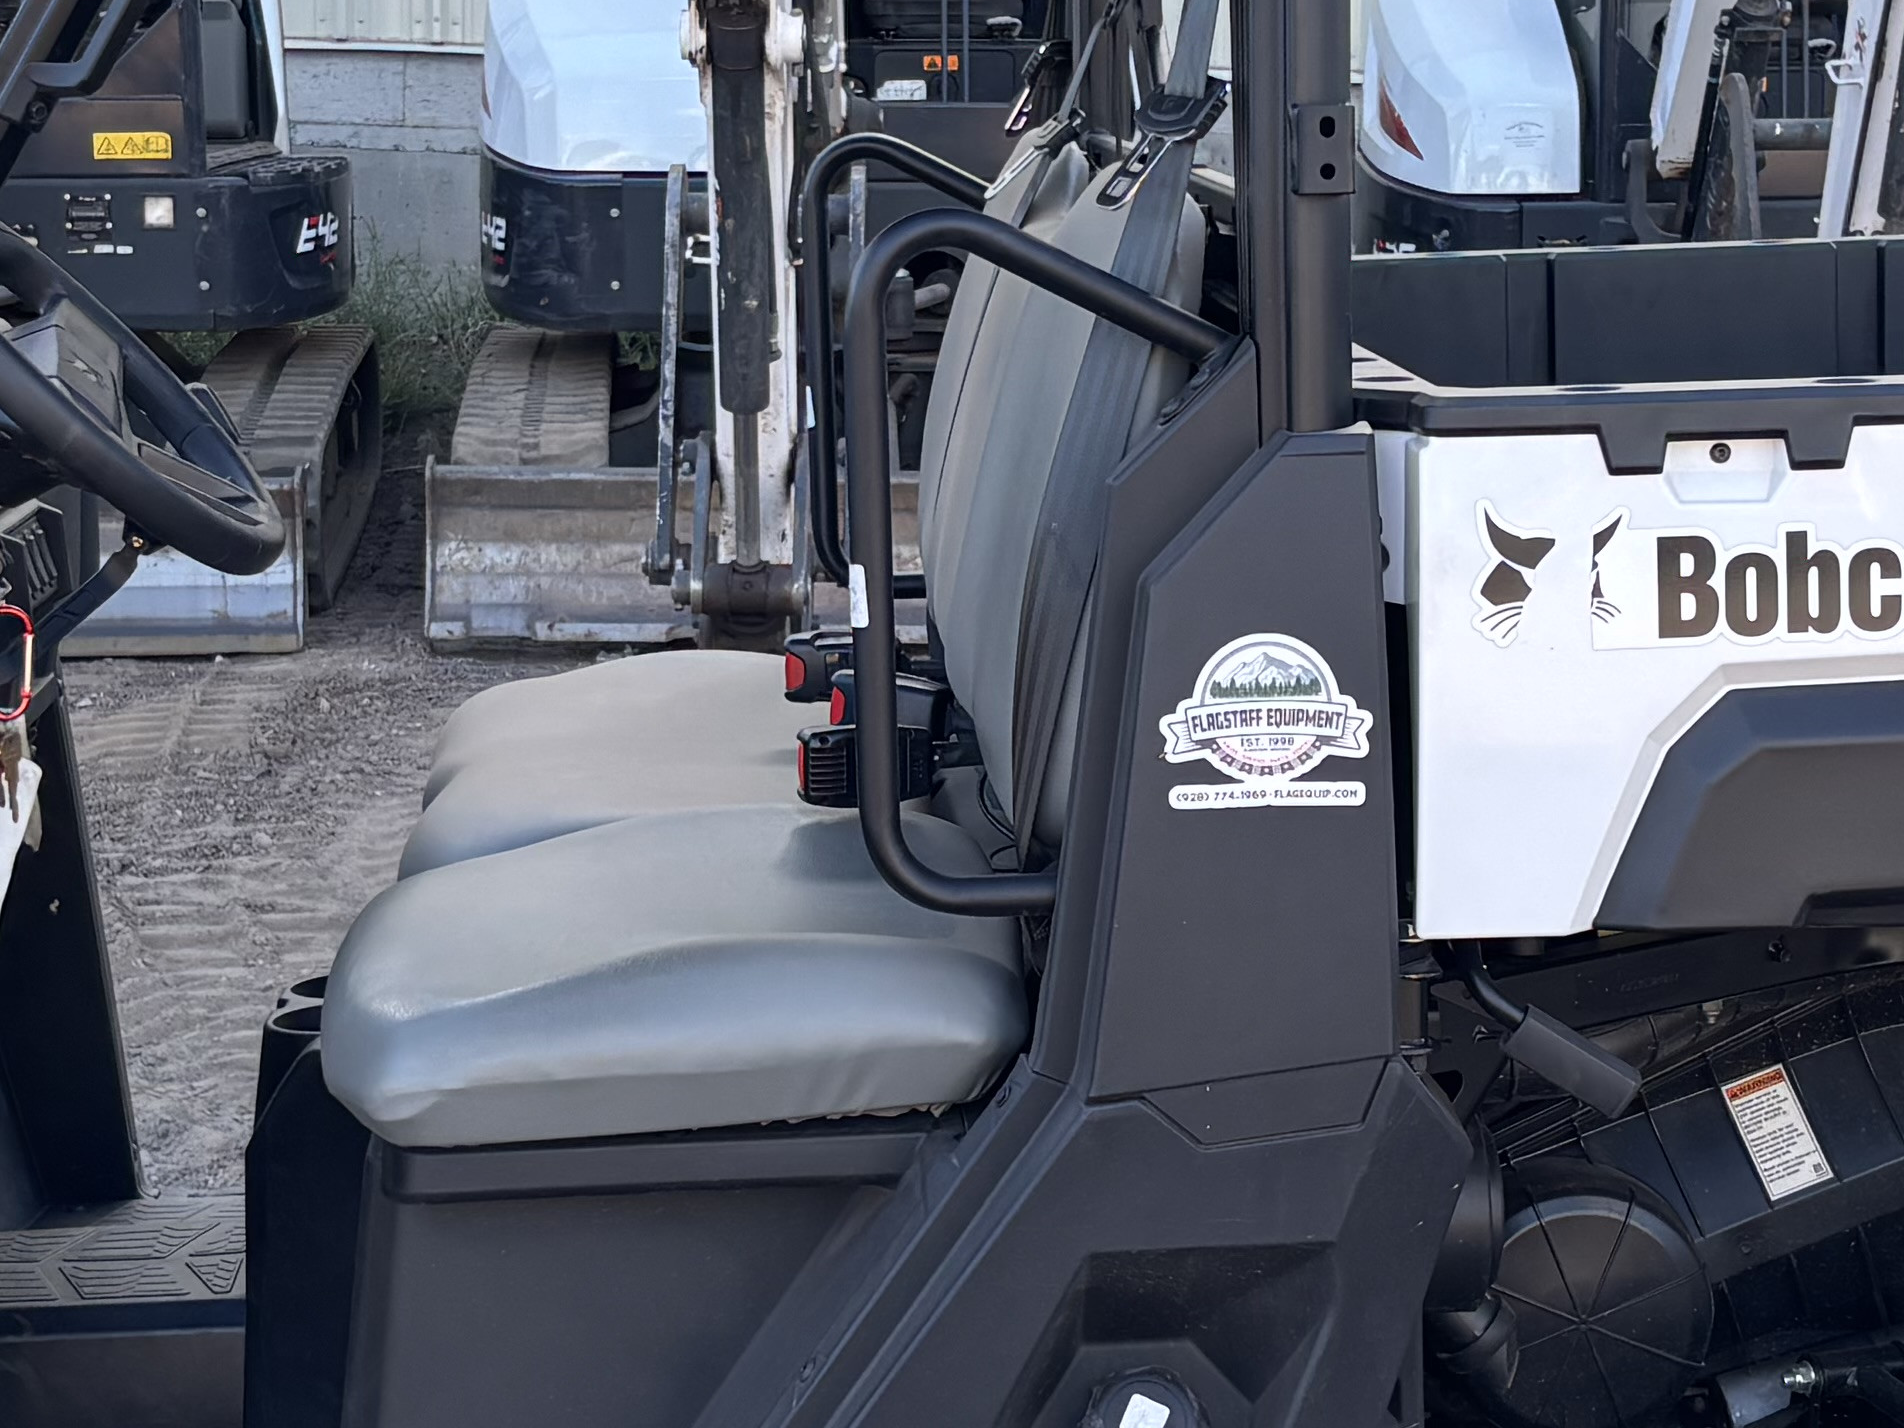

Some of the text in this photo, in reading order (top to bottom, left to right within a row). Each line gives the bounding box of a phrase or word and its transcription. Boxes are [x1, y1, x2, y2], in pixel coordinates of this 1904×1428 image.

[296, 211, 339, 254] E42
[1191, 708, 1344, 733] FLAGSTAFF EQUIPMENT
[1240, 736, 1265, 747] EST.
[1176, 792, 1210, 803] (928)
